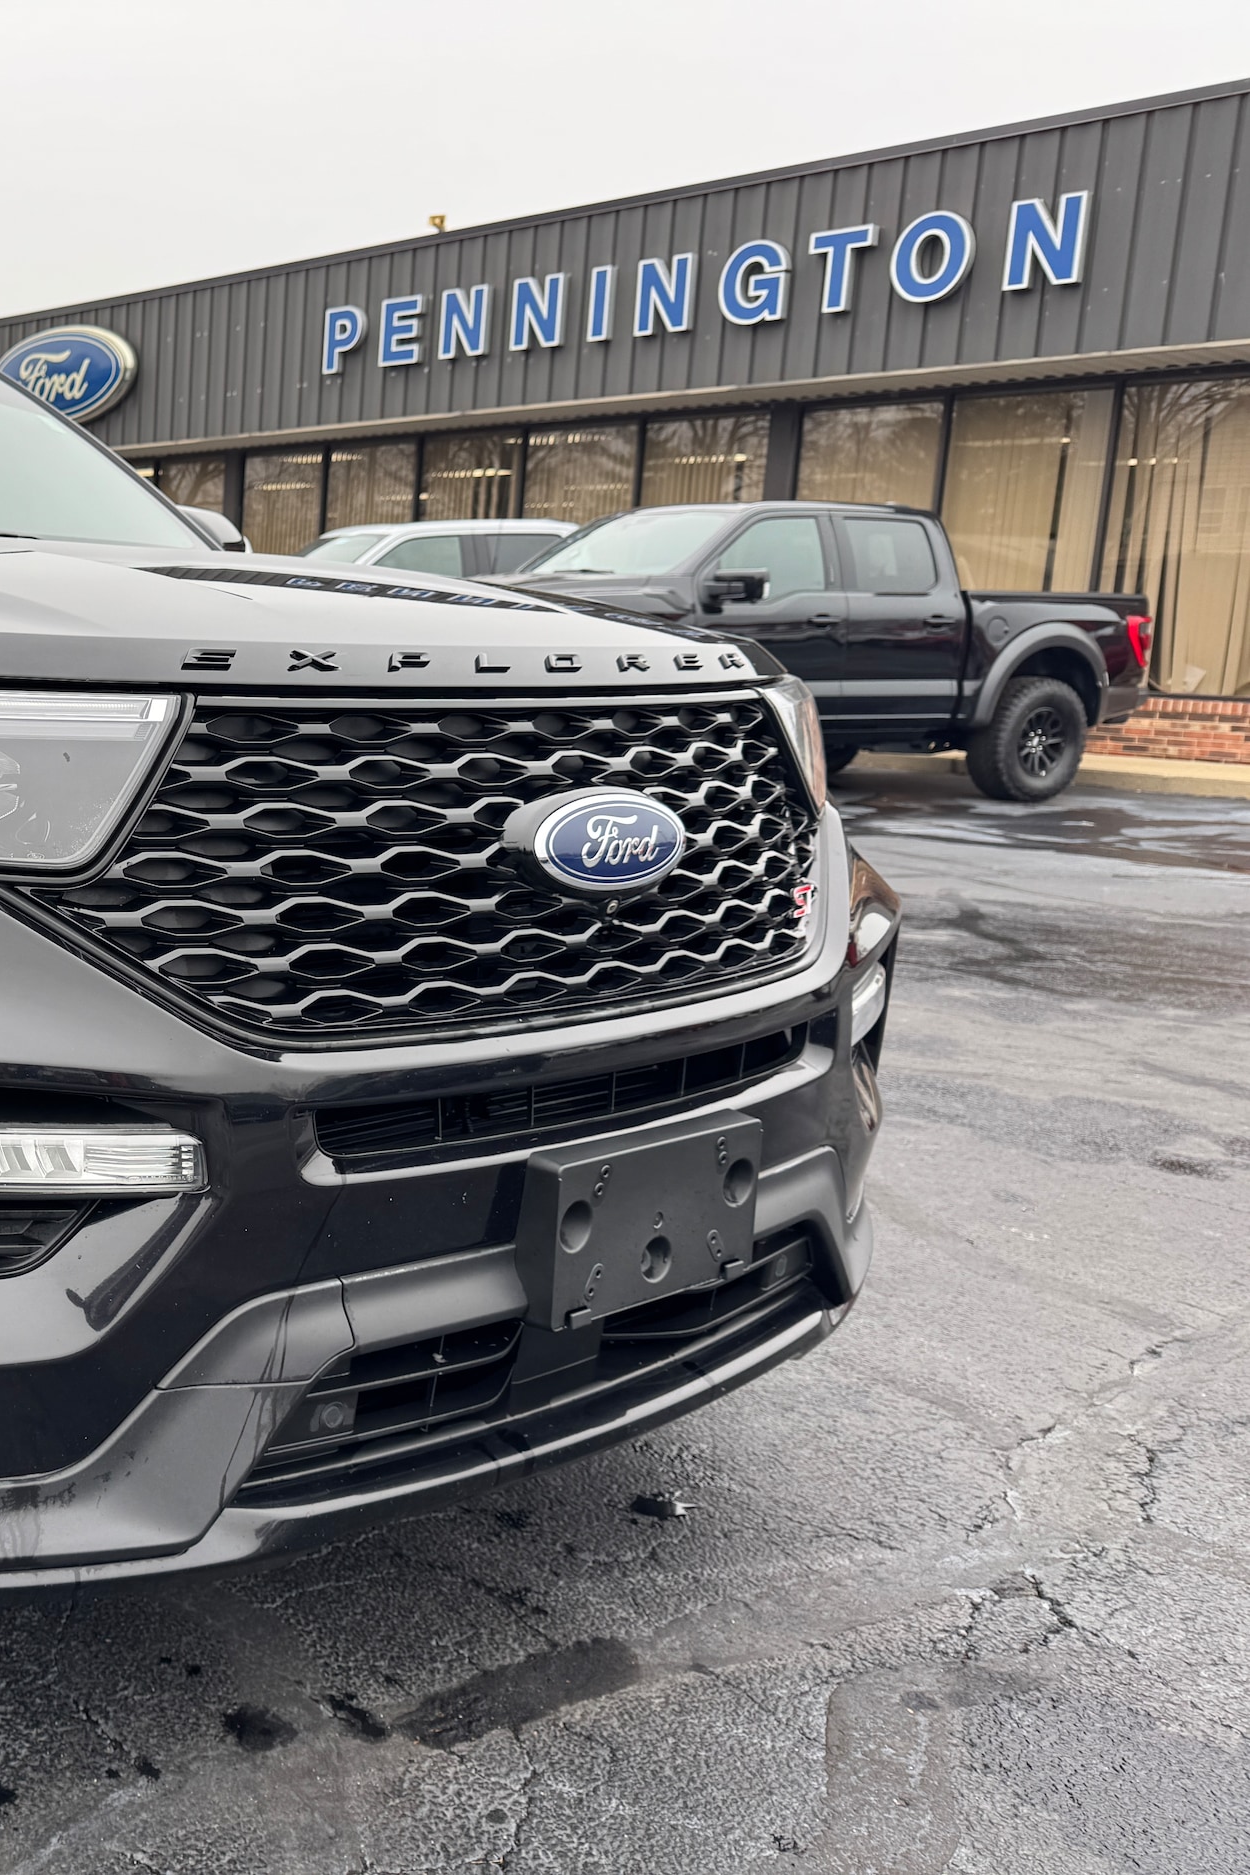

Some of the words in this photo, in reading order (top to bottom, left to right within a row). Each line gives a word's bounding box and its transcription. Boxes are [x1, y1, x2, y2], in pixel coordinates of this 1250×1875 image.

[322, 190, 1090, 375] PENNINGTON
[19, 350, 91, 402] Ford
[181, 647, 745, 672] EXPLORER
[581, 814, 658, 868] Ford
